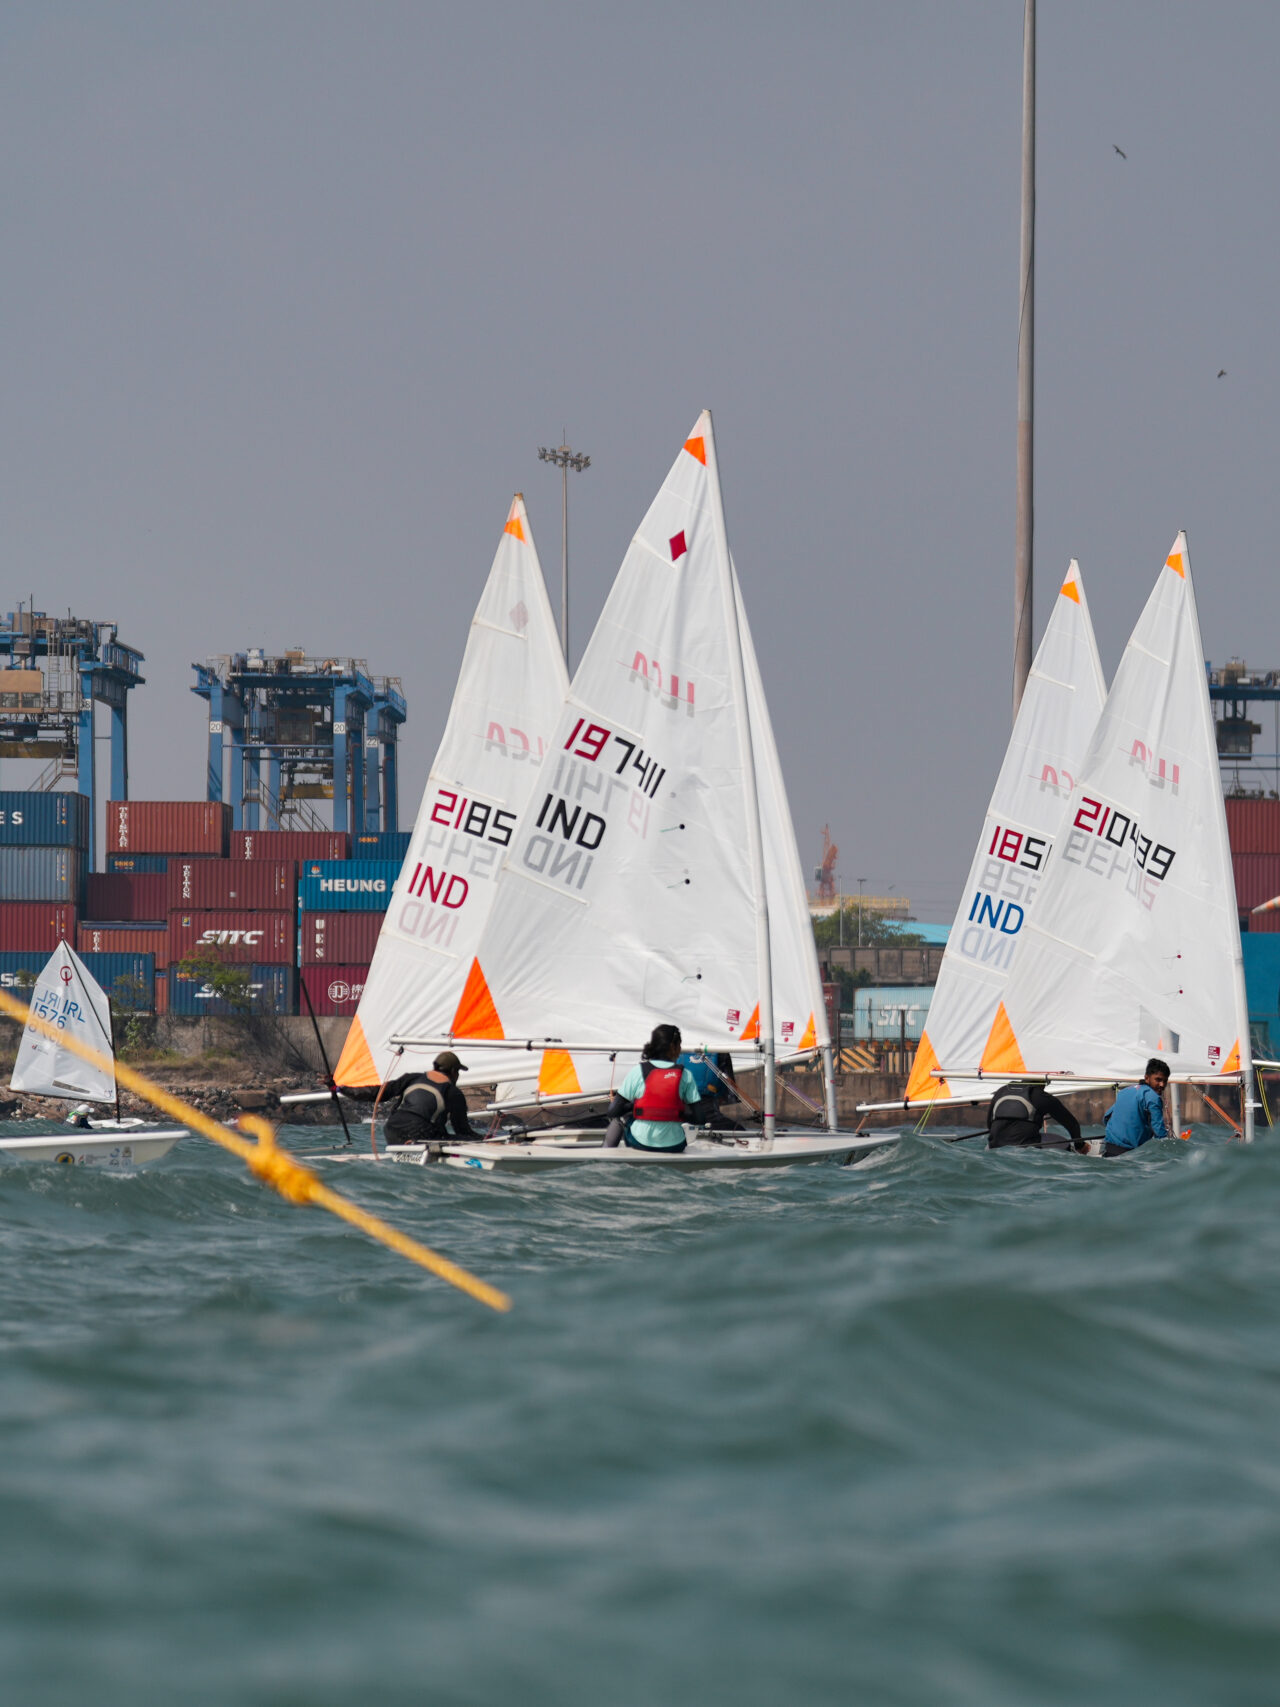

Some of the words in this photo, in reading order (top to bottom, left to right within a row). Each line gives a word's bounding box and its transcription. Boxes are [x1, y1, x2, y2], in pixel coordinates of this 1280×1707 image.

[211, 722, 221, 732] 20
[334, 723, 345, 733] 20
[367, 737, 377, 747] 22
[564, 718, 666, 798] 197411
[119, 806, 129, 847] TRISTAR
[535, 793, 606, 850] IND
[1073, 796, 1176, 880] 210439
[183, 865, 191, 899] TRITON
[320, 879, 387, 892] HEUNG
[407, 862, 469, 909] IND
[968, 892, 1025, 935] IND
[196, 930, 265, 945] SITC
[33, 1002, 66, 1029] 1576
[62, 1000, 86, 1023] IRL
[878, 1003, 920, 1026] SITC
